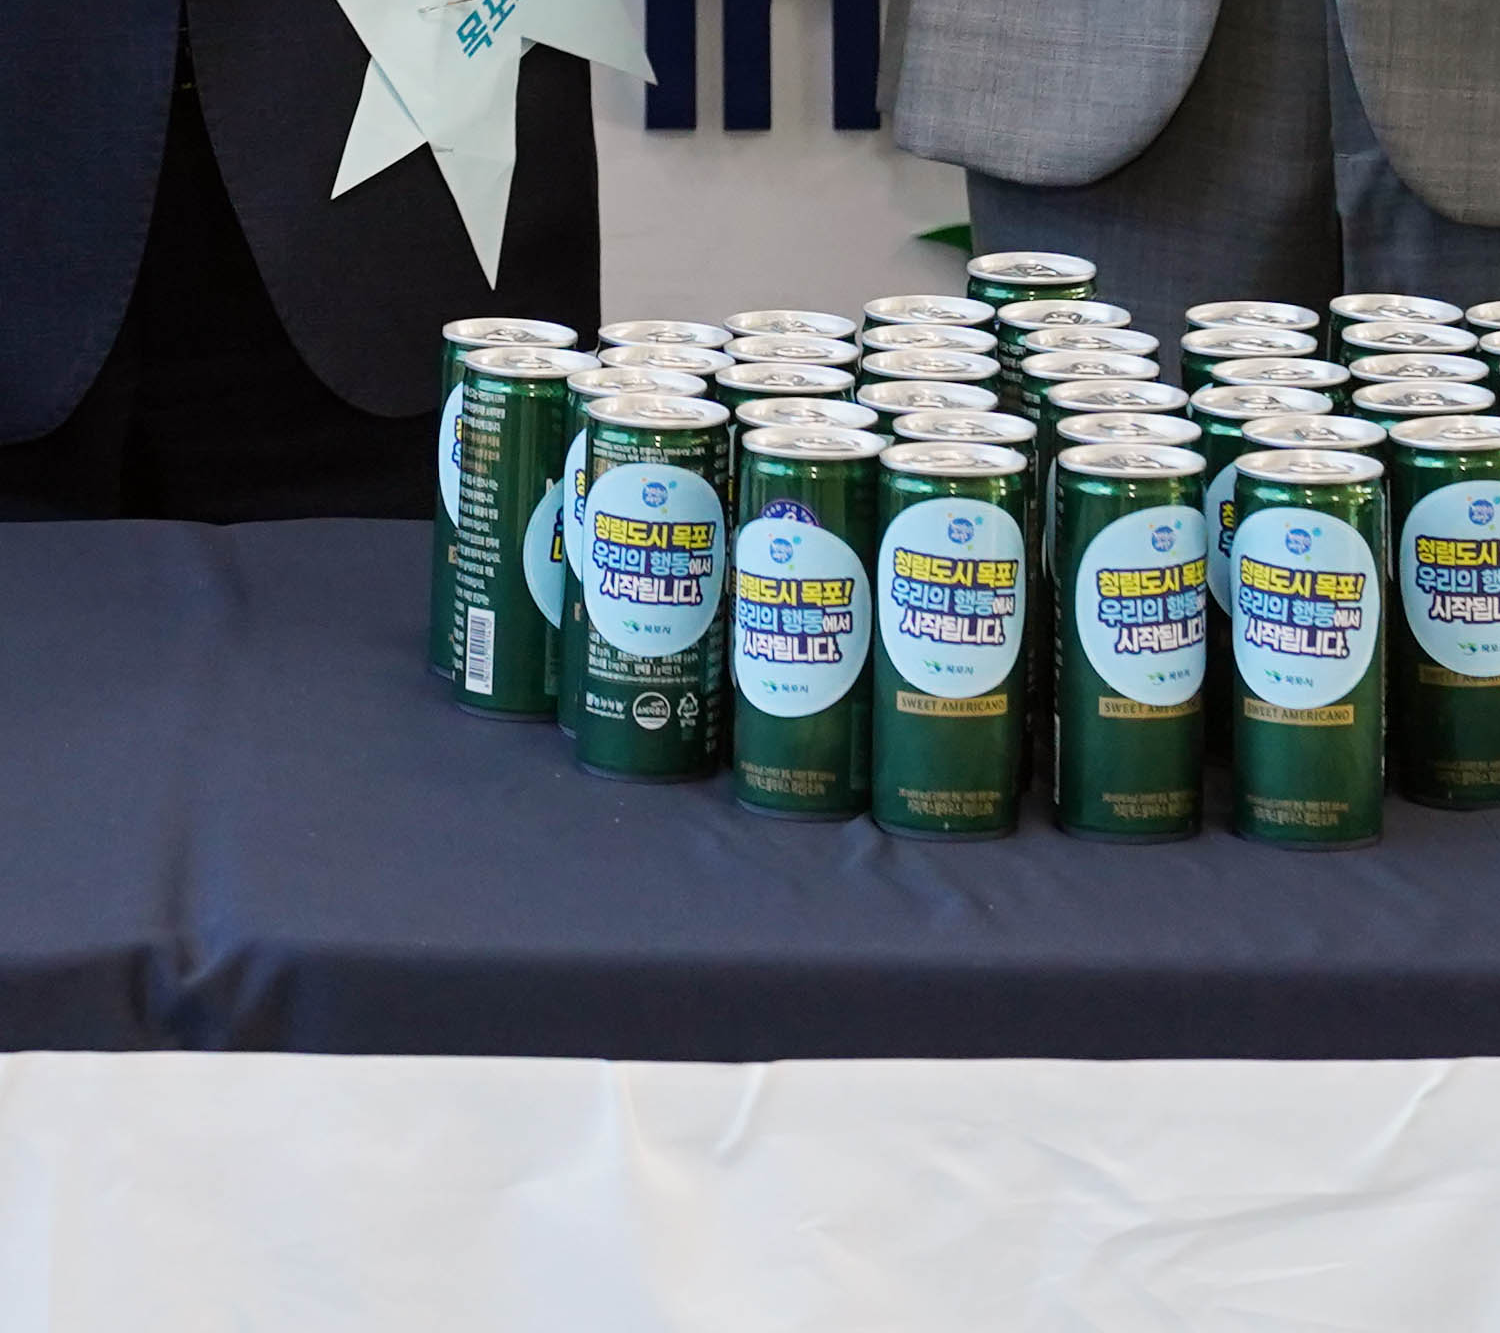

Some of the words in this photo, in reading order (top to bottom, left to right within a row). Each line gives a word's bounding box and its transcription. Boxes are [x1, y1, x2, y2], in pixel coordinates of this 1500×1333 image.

[594, 513, 667, 547] 청렴도시
[671, 521, 716, 550] 목포!
[593, 544, 646, 574] 우리의
[650, 549, 712, 577] 행동에서
[1416, 534, 1498, 566] 청렴도시
[894, 548, 973, 586] 청렴도시
[977, 559, 1018, 588] 목포!
[1098, 565, 1181, 597] 청렴도시
[1240, 557, 1312, 597] 청렴도시
[1315, 572, 1366, 601] 목포!
[1417, 565, 1478, 595] 우리의
[601, 572, 702, 605] 시작됩니다.
[739, 572, 798, 606] 청렴도시
[801, 578, 854, 606] 목포!
[892, 579, 951, 614] 우리의
[737, 603, 780, 633] 우리의
[781, 607, 852, 635] 행동에서
[1099, 596, 1165, 628] 우리의
[1239, 586, 1290, 624] 우리의
[1291, 601, 1361, 629] 행동에서
[901, 611, 1006, 645] 시작됩니다.
[1245, 622, 1350, 659] 시작됩니다.
[743, 632, 842, 663] 시작됩니다.
[1282, 707, 1350, 721] AMERICANO
